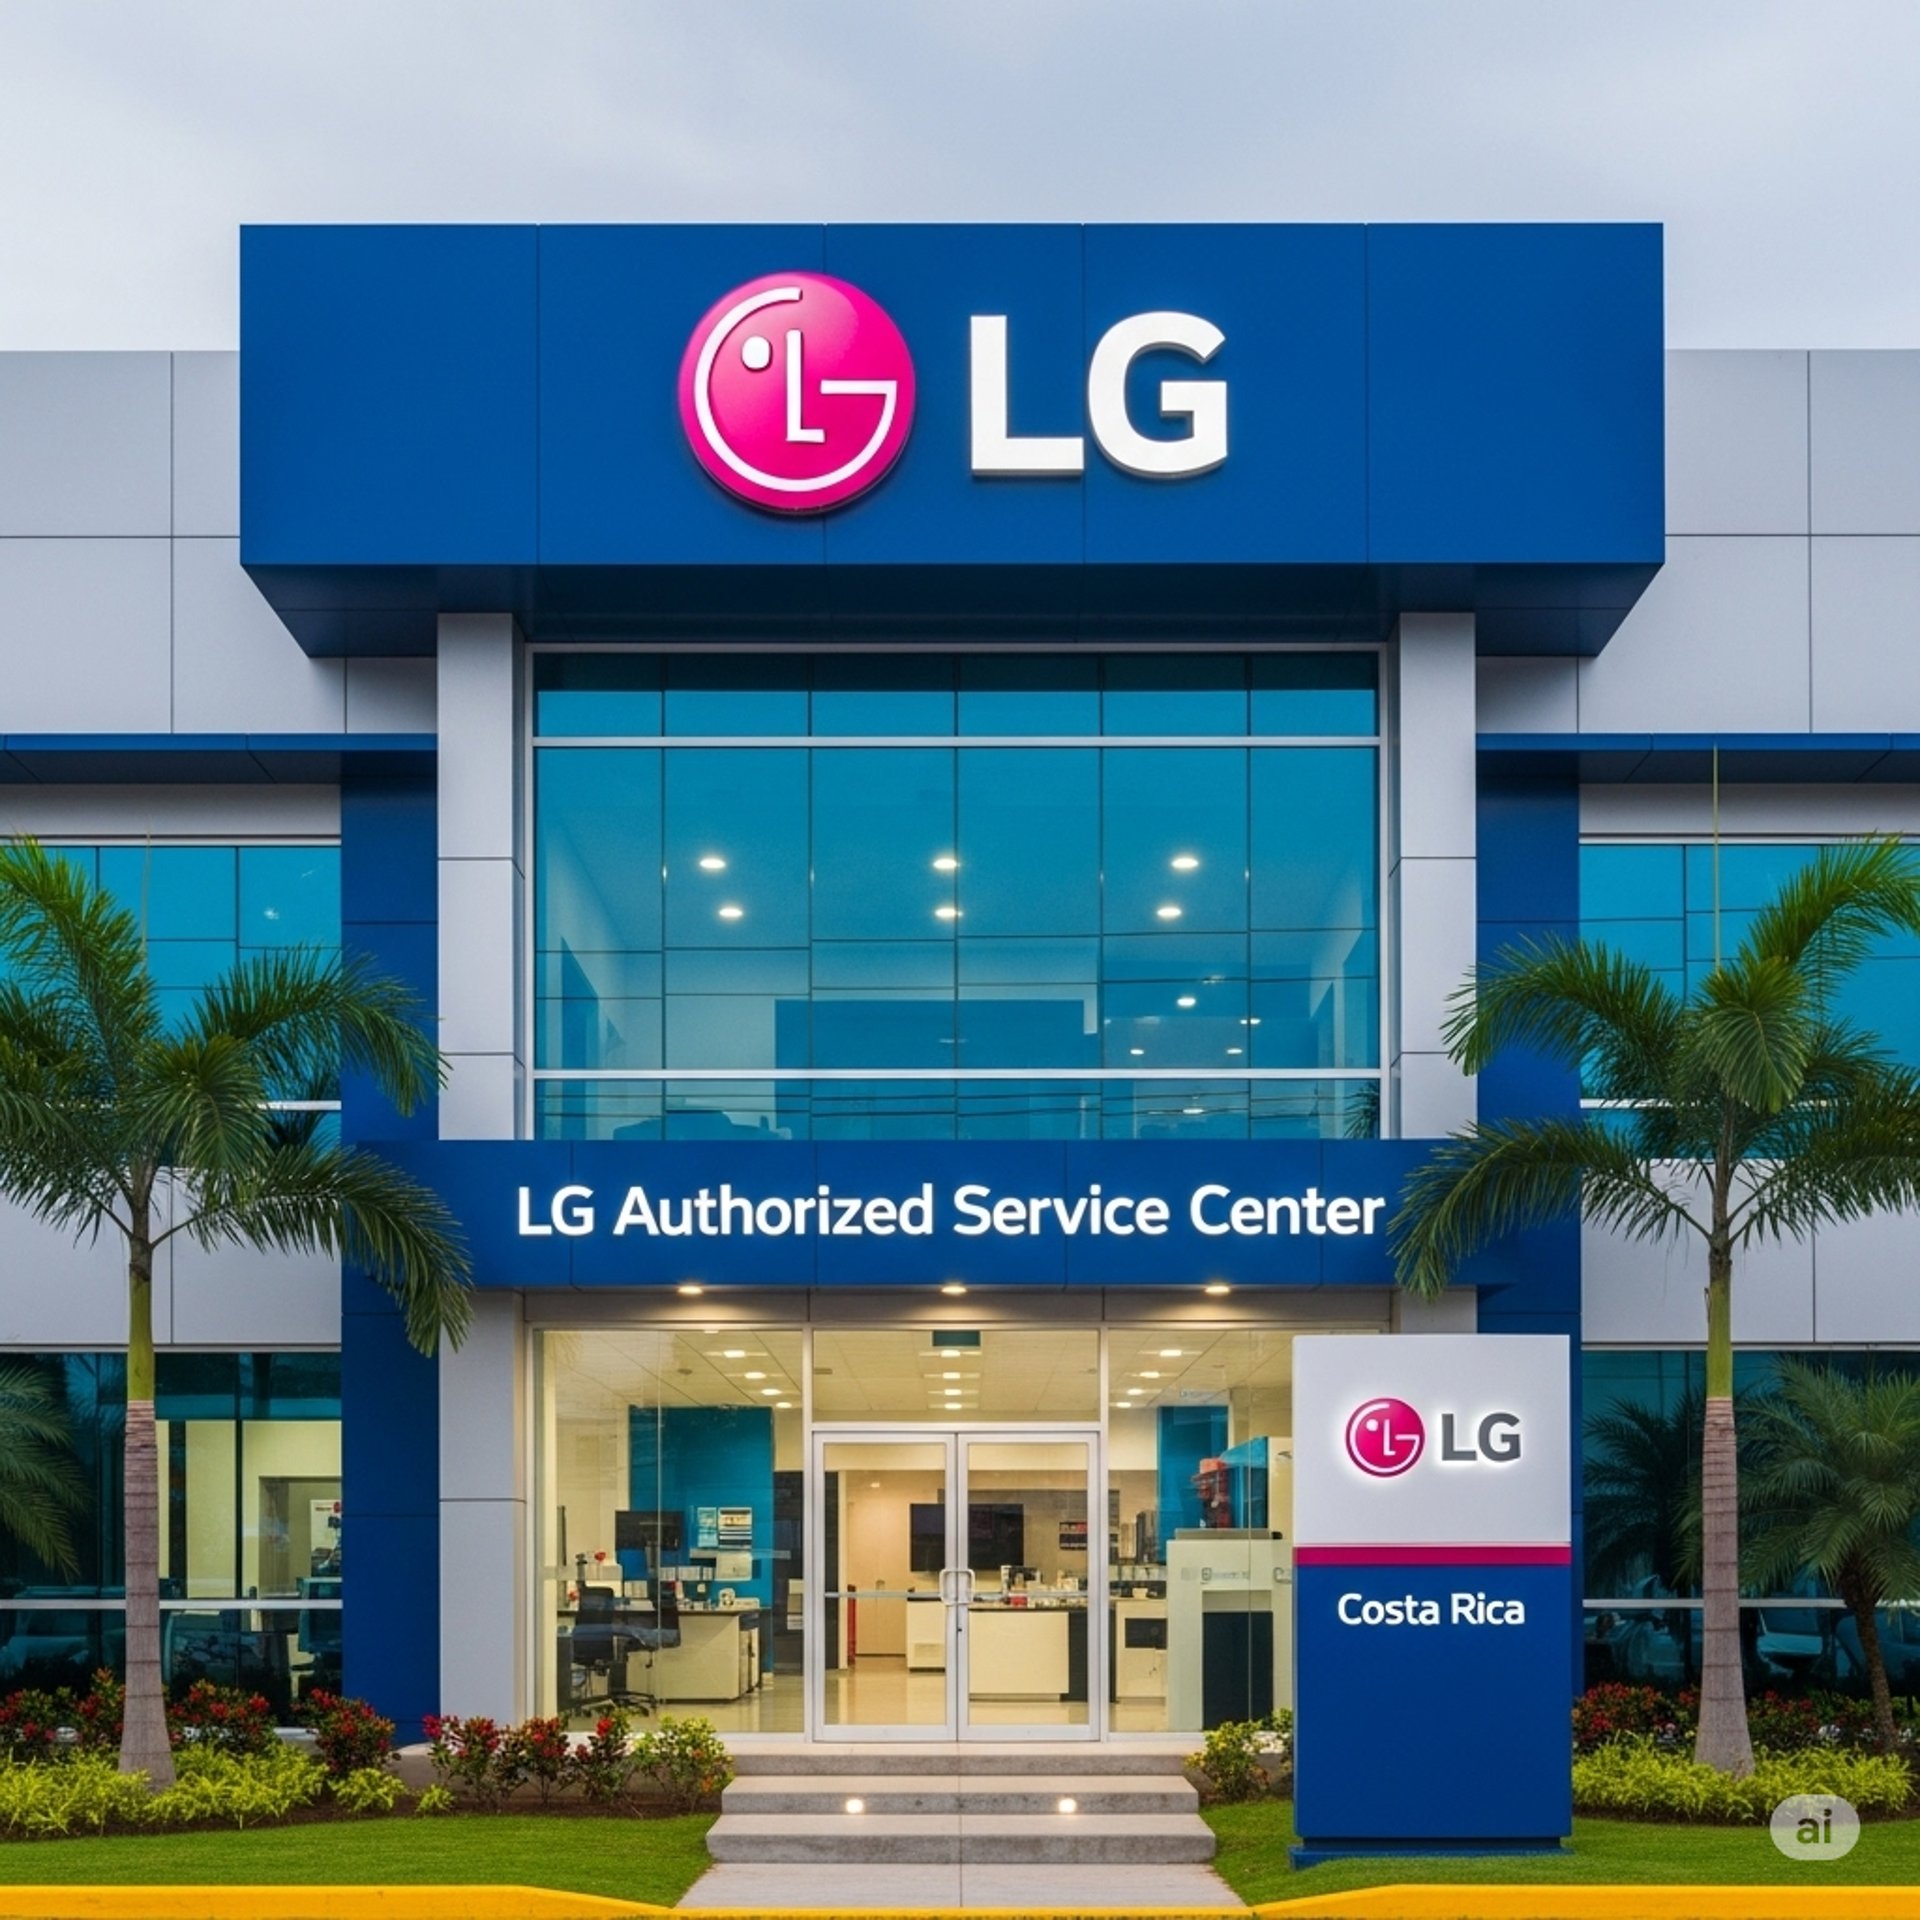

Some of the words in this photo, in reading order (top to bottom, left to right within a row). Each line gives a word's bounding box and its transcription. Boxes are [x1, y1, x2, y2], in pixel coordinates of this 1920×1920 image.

[970, 311, 1228, 478] LG
[518, 1186, 593, 1236] LG
[613, 1183, 933, 1236] Authorized
[954, 1184, 1170, 1236] Service
[1191, 1184, 1385, 1236] Center
[1441, 1413, 1521, 1462] LG
[1338, 1593, 1440, 1625] Costa
[1451, 1593, 1525, 1625] Rica
